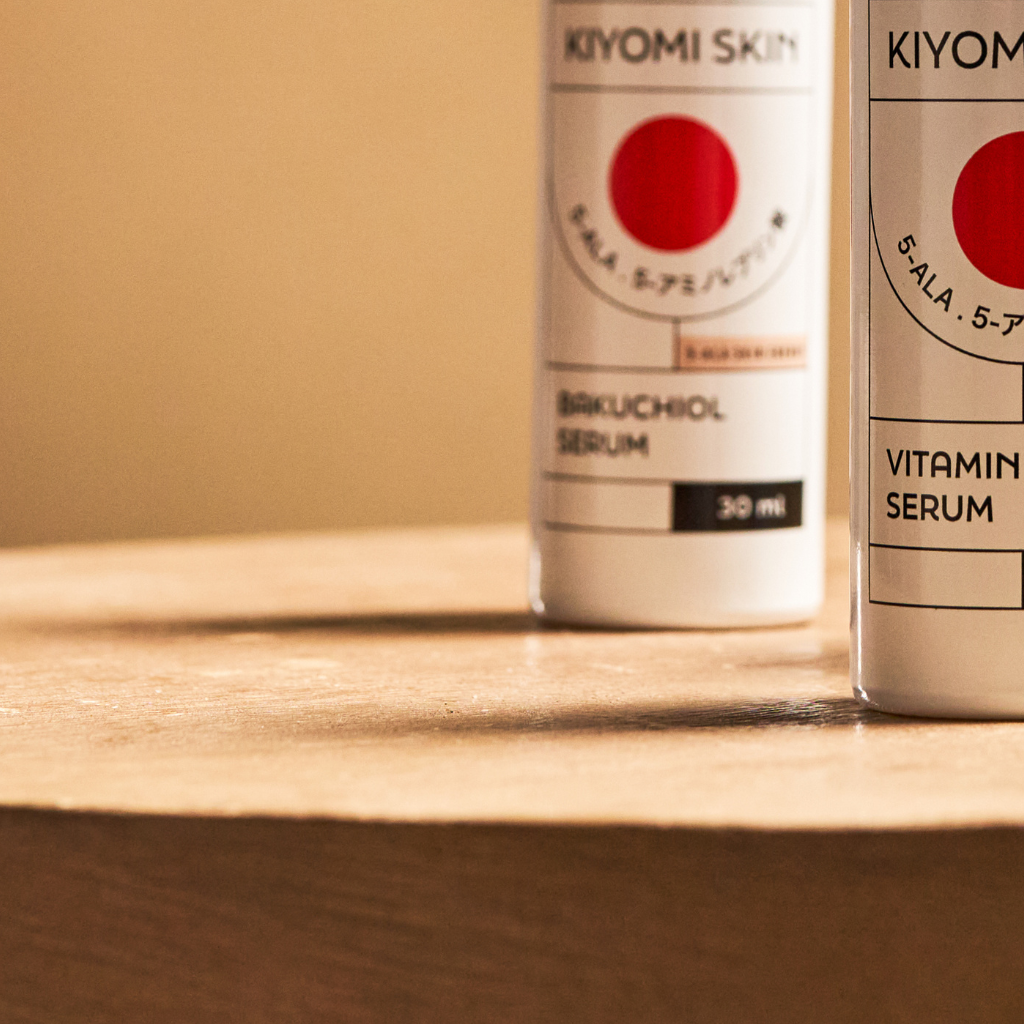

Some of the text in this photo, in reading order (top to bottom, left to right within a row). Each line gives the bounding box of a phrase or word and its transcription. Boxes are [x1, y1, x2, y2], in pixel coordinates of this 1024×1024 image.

[564, 27, 798, 65] KIYOMI SKIN
[898, 234, 953, 312] 5-ALA
[556, 389, 726, 422] BAKUCHIOL
[556, 427, 650, 459] SERUM
[886, 449, 1019, 479] VITAMIN
[716, 493, 786, 520] 30 ml
[886, 492, 994, 522] SERUM
